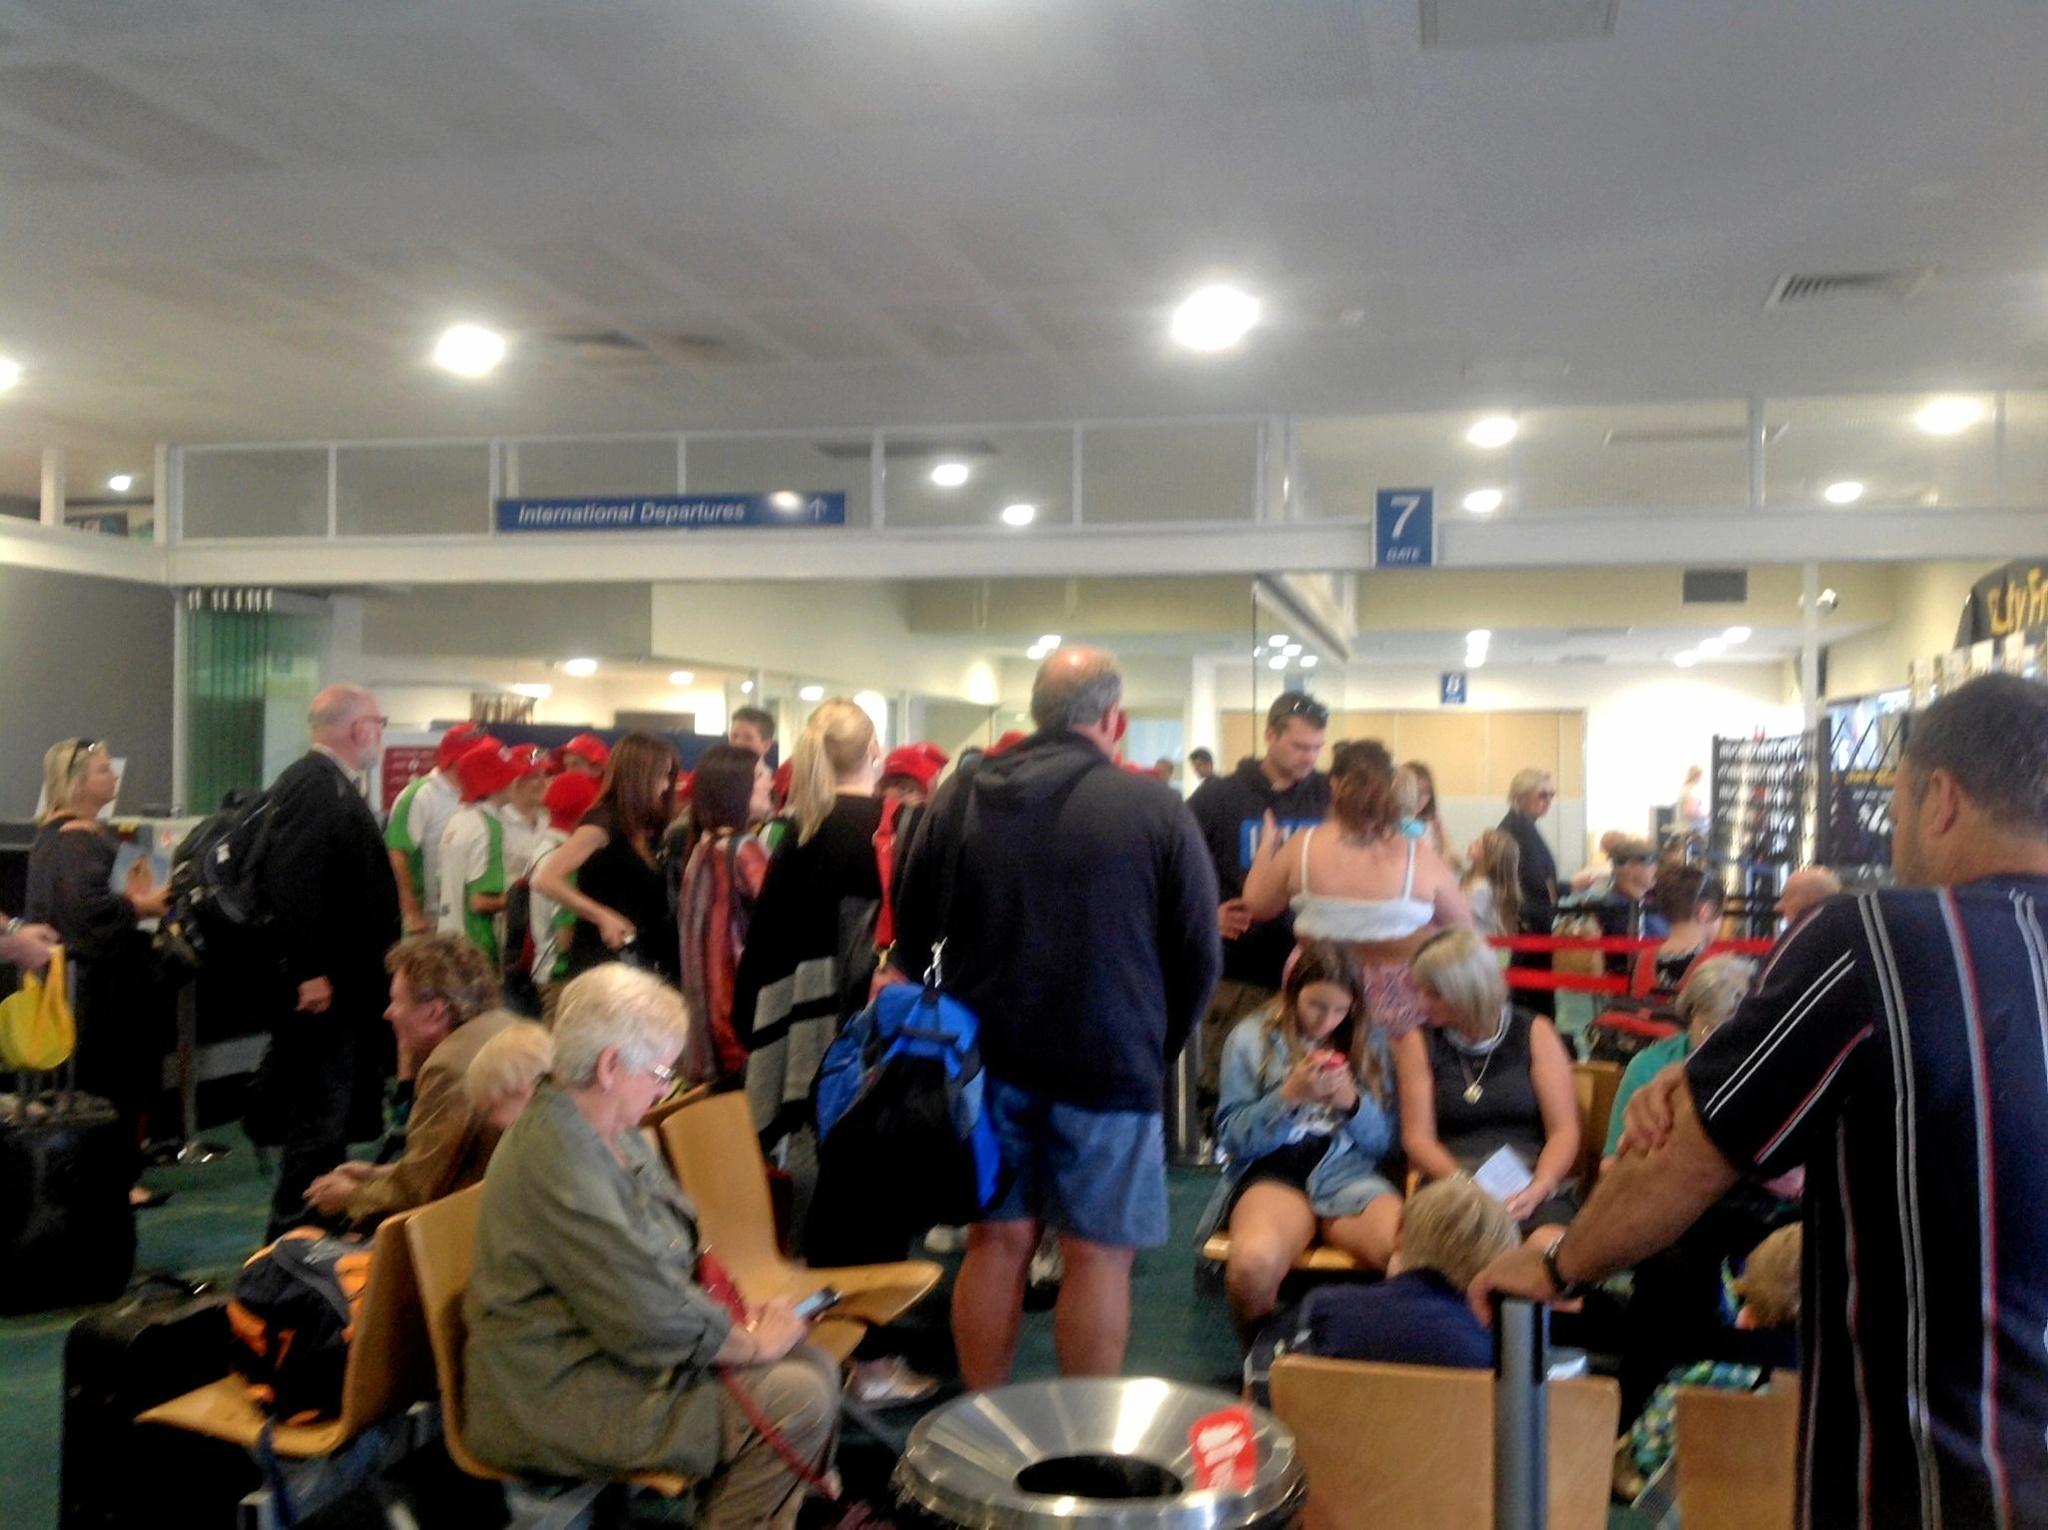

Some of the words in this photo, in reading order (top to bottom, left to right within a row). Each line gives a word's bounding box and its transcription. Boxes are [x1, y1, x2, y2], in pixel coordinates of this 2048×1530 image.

[518, 503, 635, 525] International
[640, 501, 745, 527] Departures
[1390, 495, 1420, 539] 7
